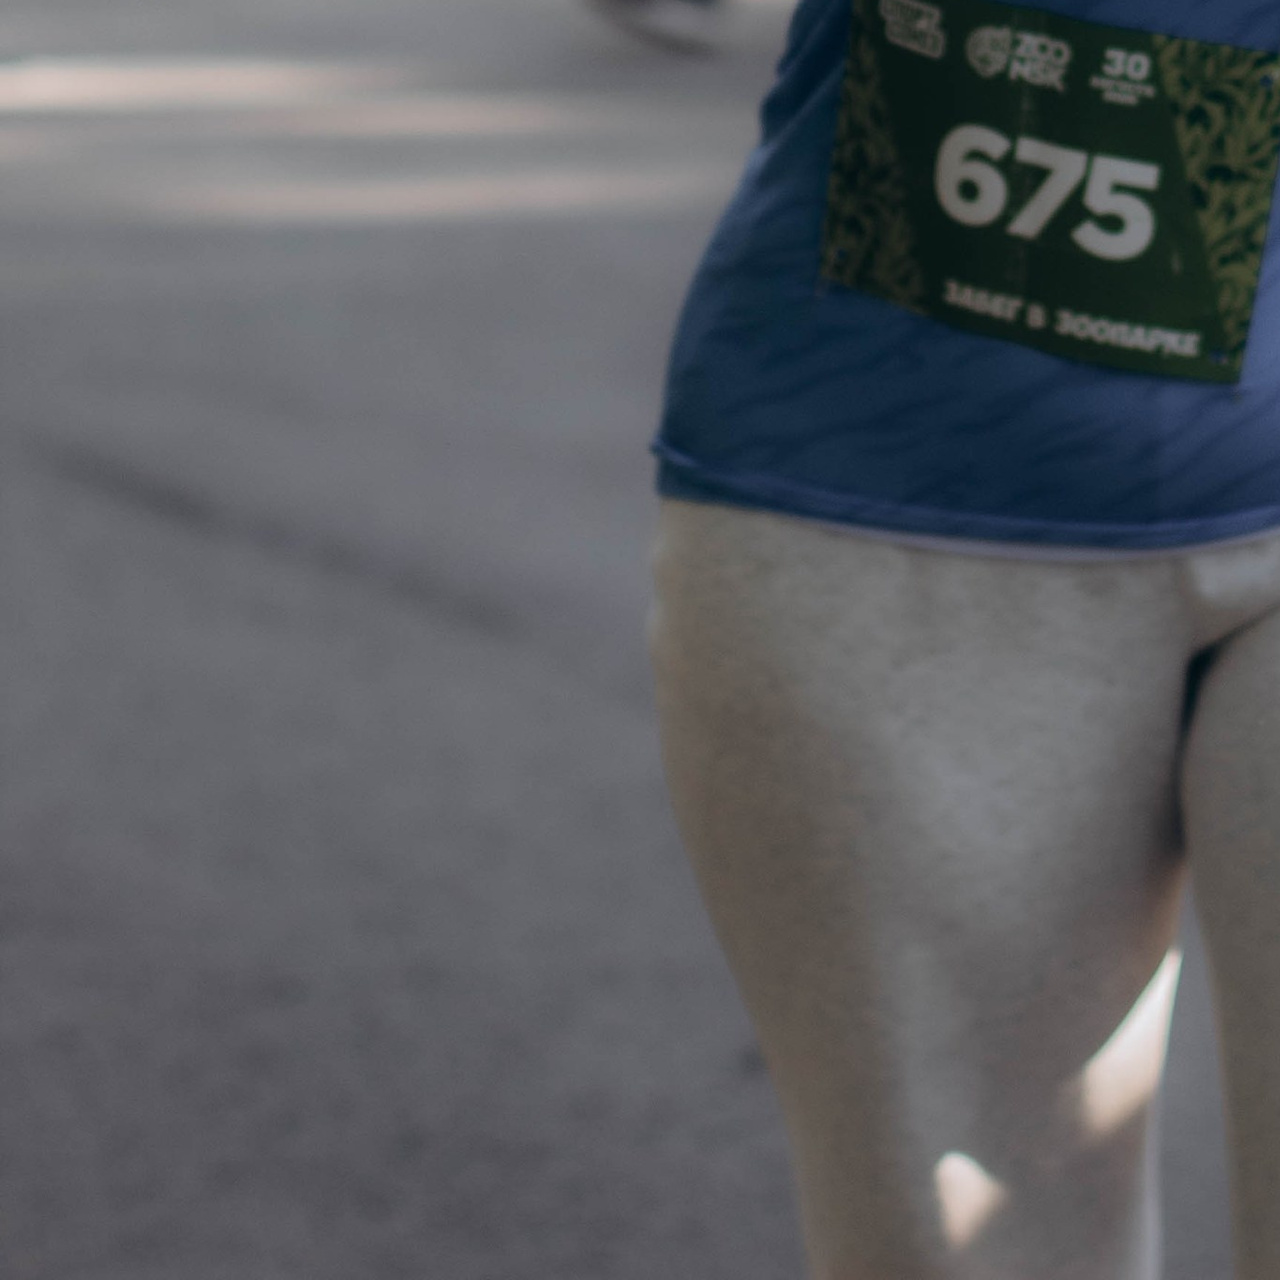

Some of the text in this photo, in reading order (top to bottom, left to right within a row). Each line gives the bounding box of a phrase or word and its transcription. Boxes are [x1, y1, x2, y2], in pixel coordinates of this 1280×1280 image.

[1014, 31, 1071, 65] ZOO
[1103, 50, 1149, 80] 30
[935, 124, 1160, 260] 675
